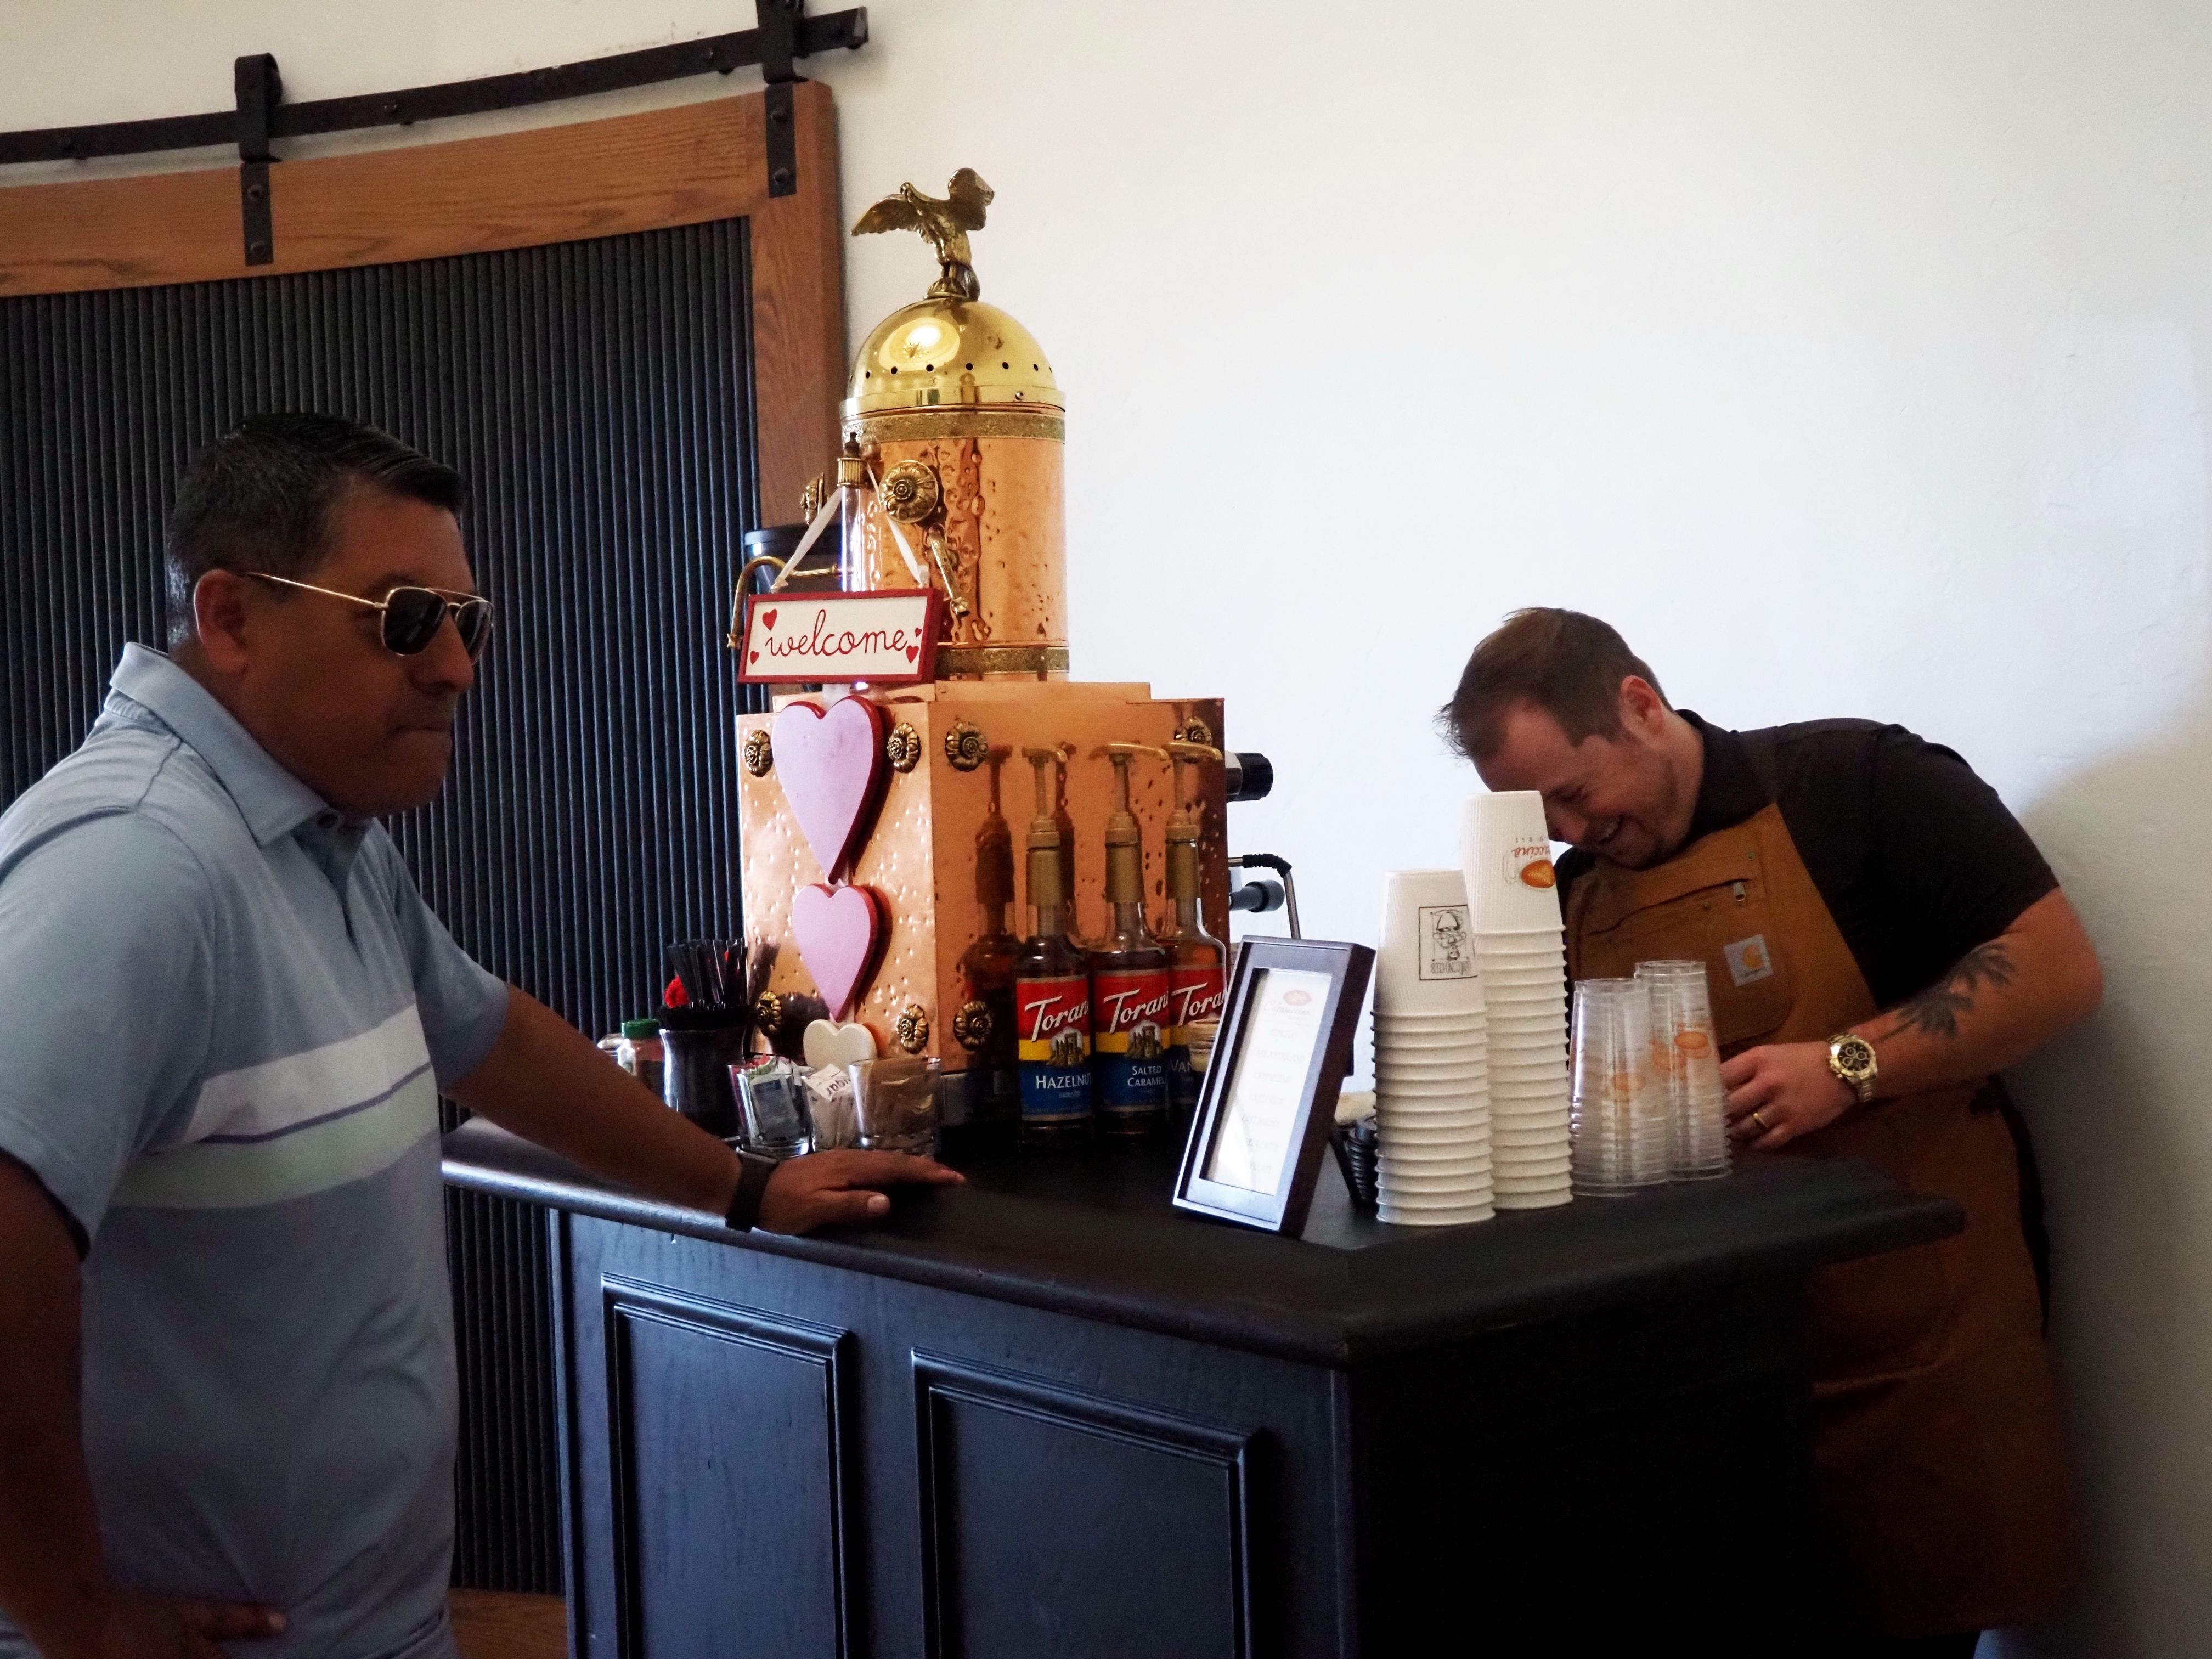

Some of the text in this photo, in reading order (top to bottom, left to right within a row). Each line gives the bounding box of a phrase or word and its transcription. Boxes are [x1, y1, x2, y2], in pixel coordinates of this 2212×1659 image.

[765, 608, 908, 657] welcome
[1025, 995, 1090, 1043] Toran
[1171, 981, 1225, 1028] Tora
[1127, 1076, 1166, 1087] CARAMEL
[1132, 1065, 1162, 1075] SALTED
[826, 1079, 851, 1096] ugar
